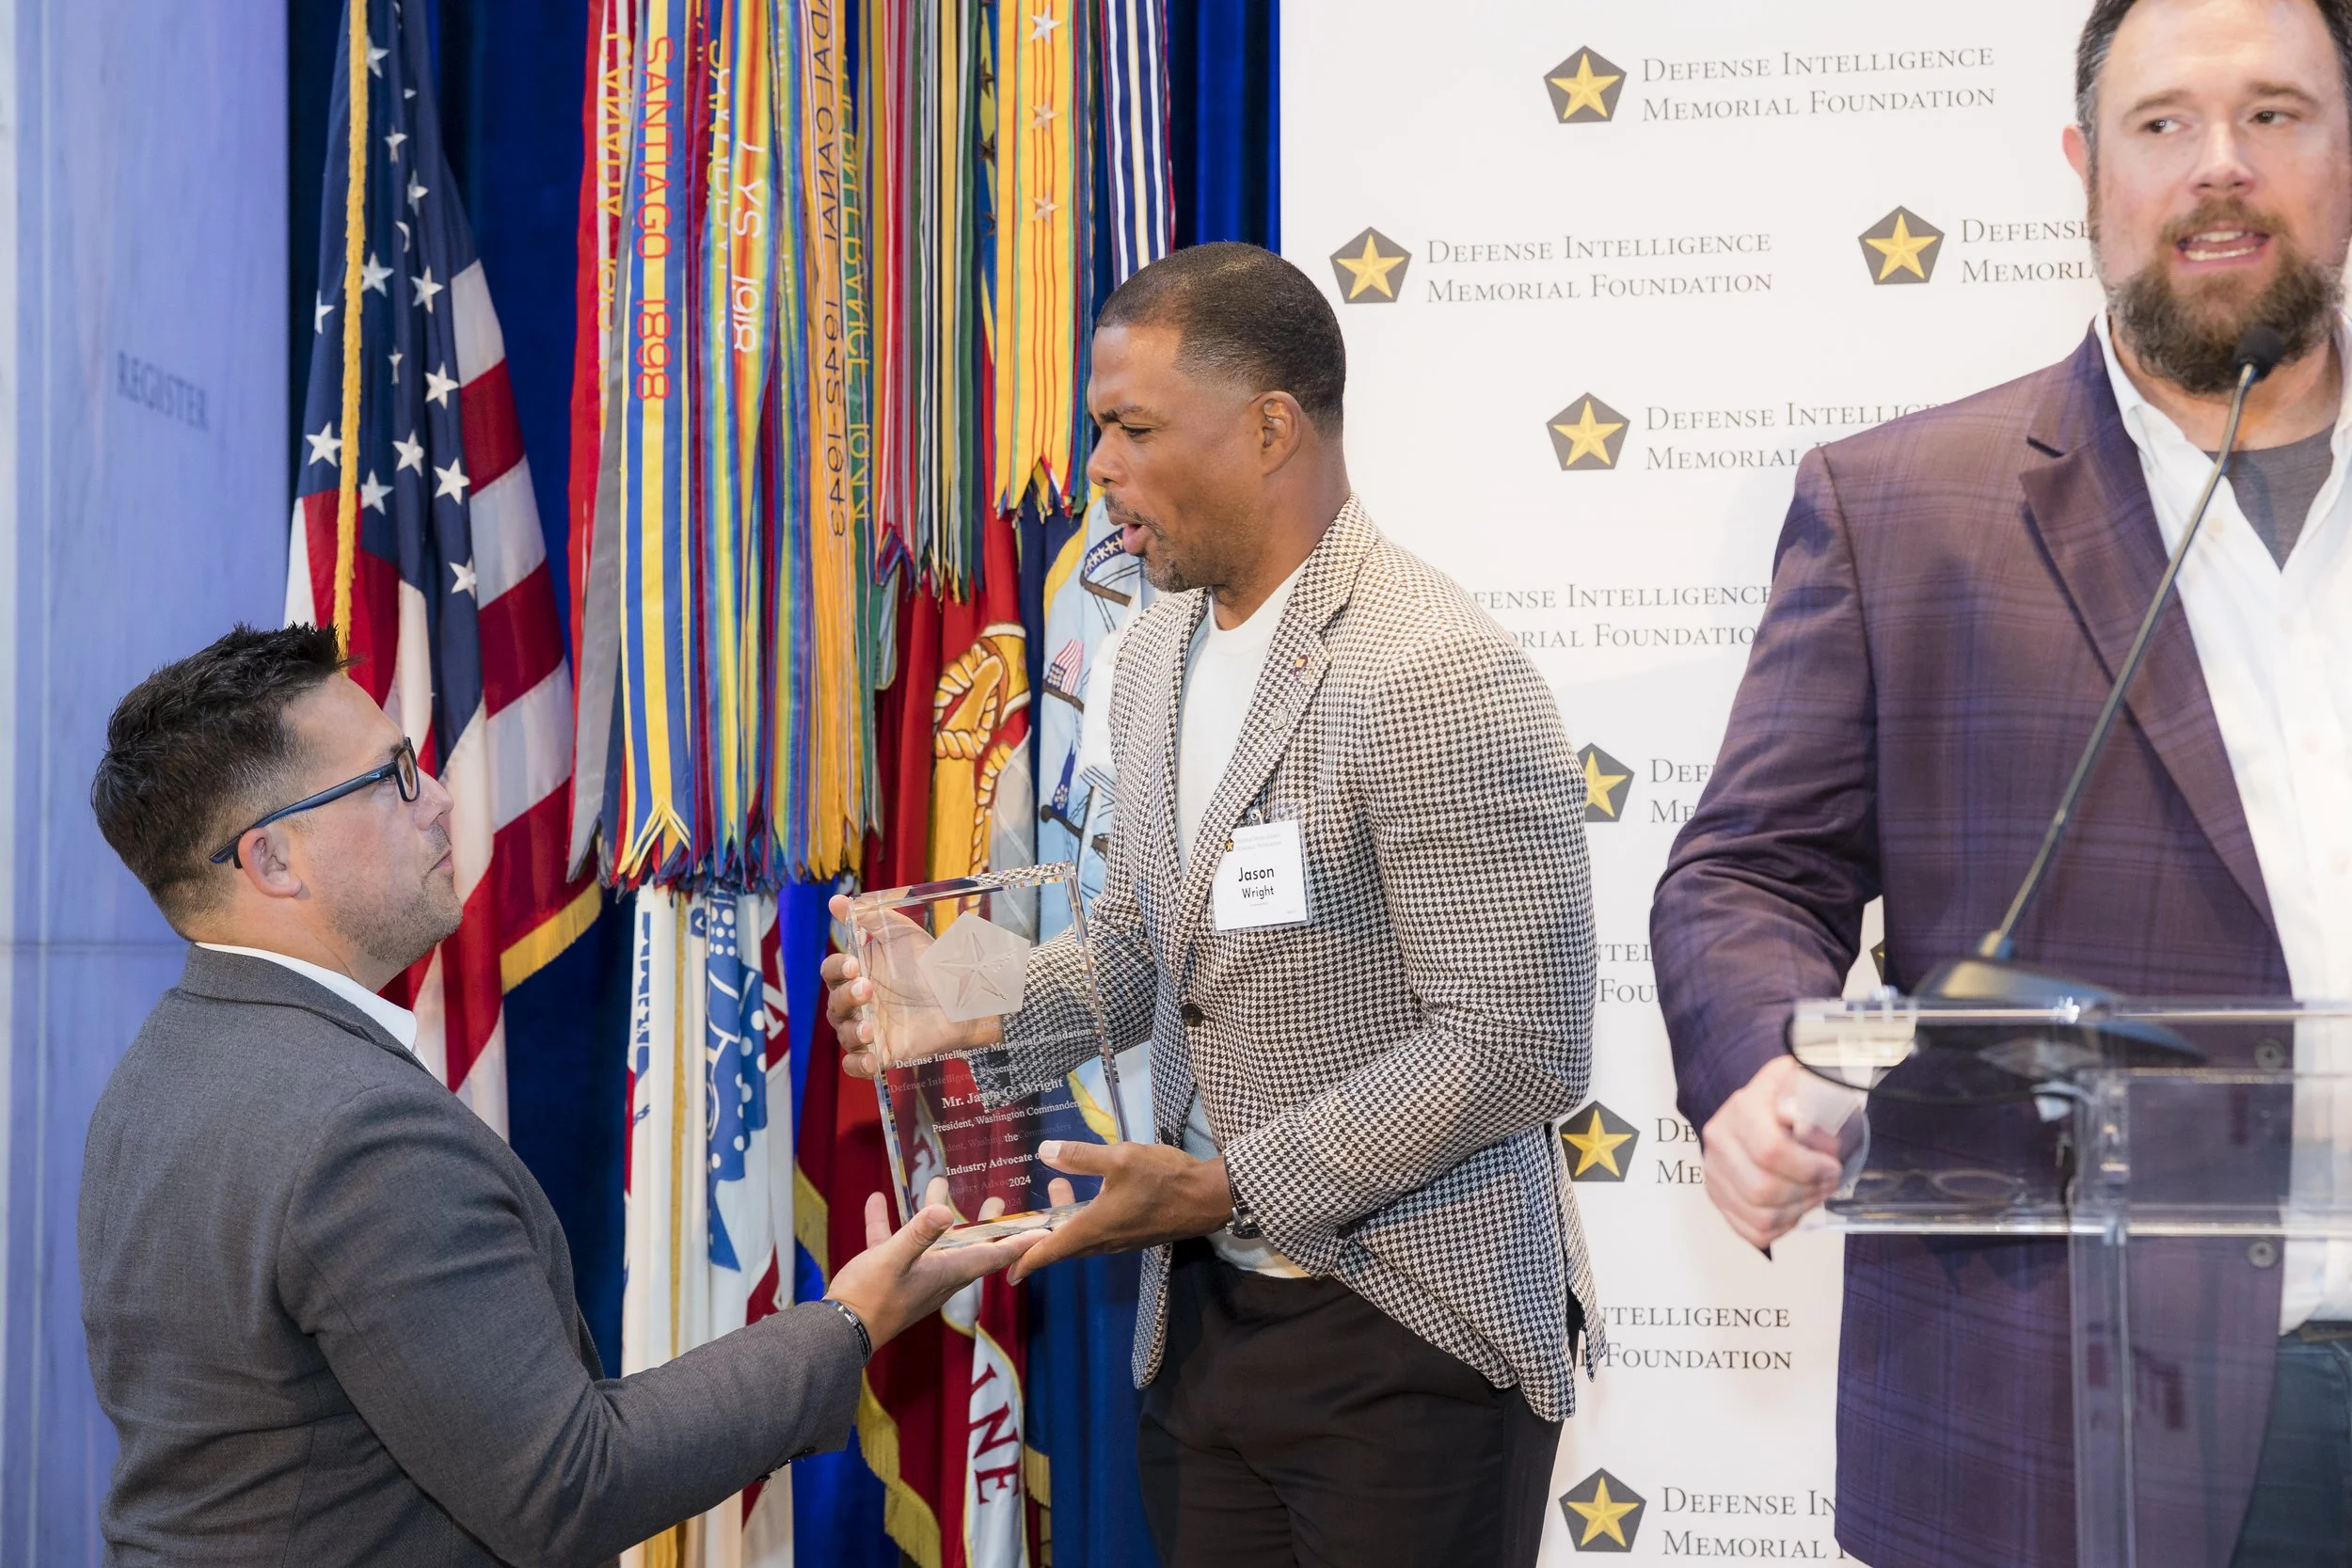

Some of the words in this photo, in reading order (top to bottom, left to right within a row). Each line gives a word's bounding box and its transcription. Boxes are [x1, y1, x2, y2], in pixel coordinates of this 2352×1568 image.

[1642, 56, 1771, 83] DEFENSE
[1783, 47, 1994, 75] INTELLIGENCE
[1642, 97, 1799, 122] MEMORIAL
[1808, 87, 1996, 115] FOUNDATION
[637, 36, 675, 260] SANTIAGO
[732, 140, 765, 240] LYS
[1426, 240, 1553, 264] DEFENSE
[1564, 233, 1772, 260] INTELLIGENCE
[1961, 259, 2096, 284] MEMORI
[1426, 278, 1581, 303] MEMORIAL
[1590, 273, 1773, 298] FOUNDATION
[732, 274, 760, 354] 1918
[635, 299, 672, 400] 1898
[1646, 406, 1776, 431] DEFENSE
[1646, 446, 1799, 470] MEMORIAL
[1472, 590, 1556, 610] FENSE
[1594, 623, 1756, 647] FOUNDATIO
[1238, 867, 1275, 882] Jason
[1242, 885, 1275, 900] Wright
[896, 1055, 933, 1069] Defense
[933, 1045, 989, 1062] Intelligence
[989, 1037, 1036, 1053] Memorial
[1037, 1028, 1093, 1043] Foundation
[941, 1096, 964, 1109] Mr.
[966, 1091, 1001, 1104] Jason
[1002, 1085, 1018, 1098] G.
[1018, 1077, 1064, 1093] Wright
[931, 1117, 975, 1133] President,
[974, 1107, 1025, 1125] Washington
[1026, 1100, 1082, 1117] Commanders
[1003, 1132, 1020, 1143] the
[945, 1161, 987, 1177] Industry
[988, 1152, 1033, 1169] Advocate
[1009, 1175, 1032, 1189] 2024
[1601, 1306, 1791, 1328] TELLIGENCE
[1604, 1341, 1792, 1370] FOUNDATION
[969, 1362, 1021, 1505] INE
[1661, 1486, 1796, 1515] DEFENSE
[1661, 1528, 1828, 1560] MEMORIAL
